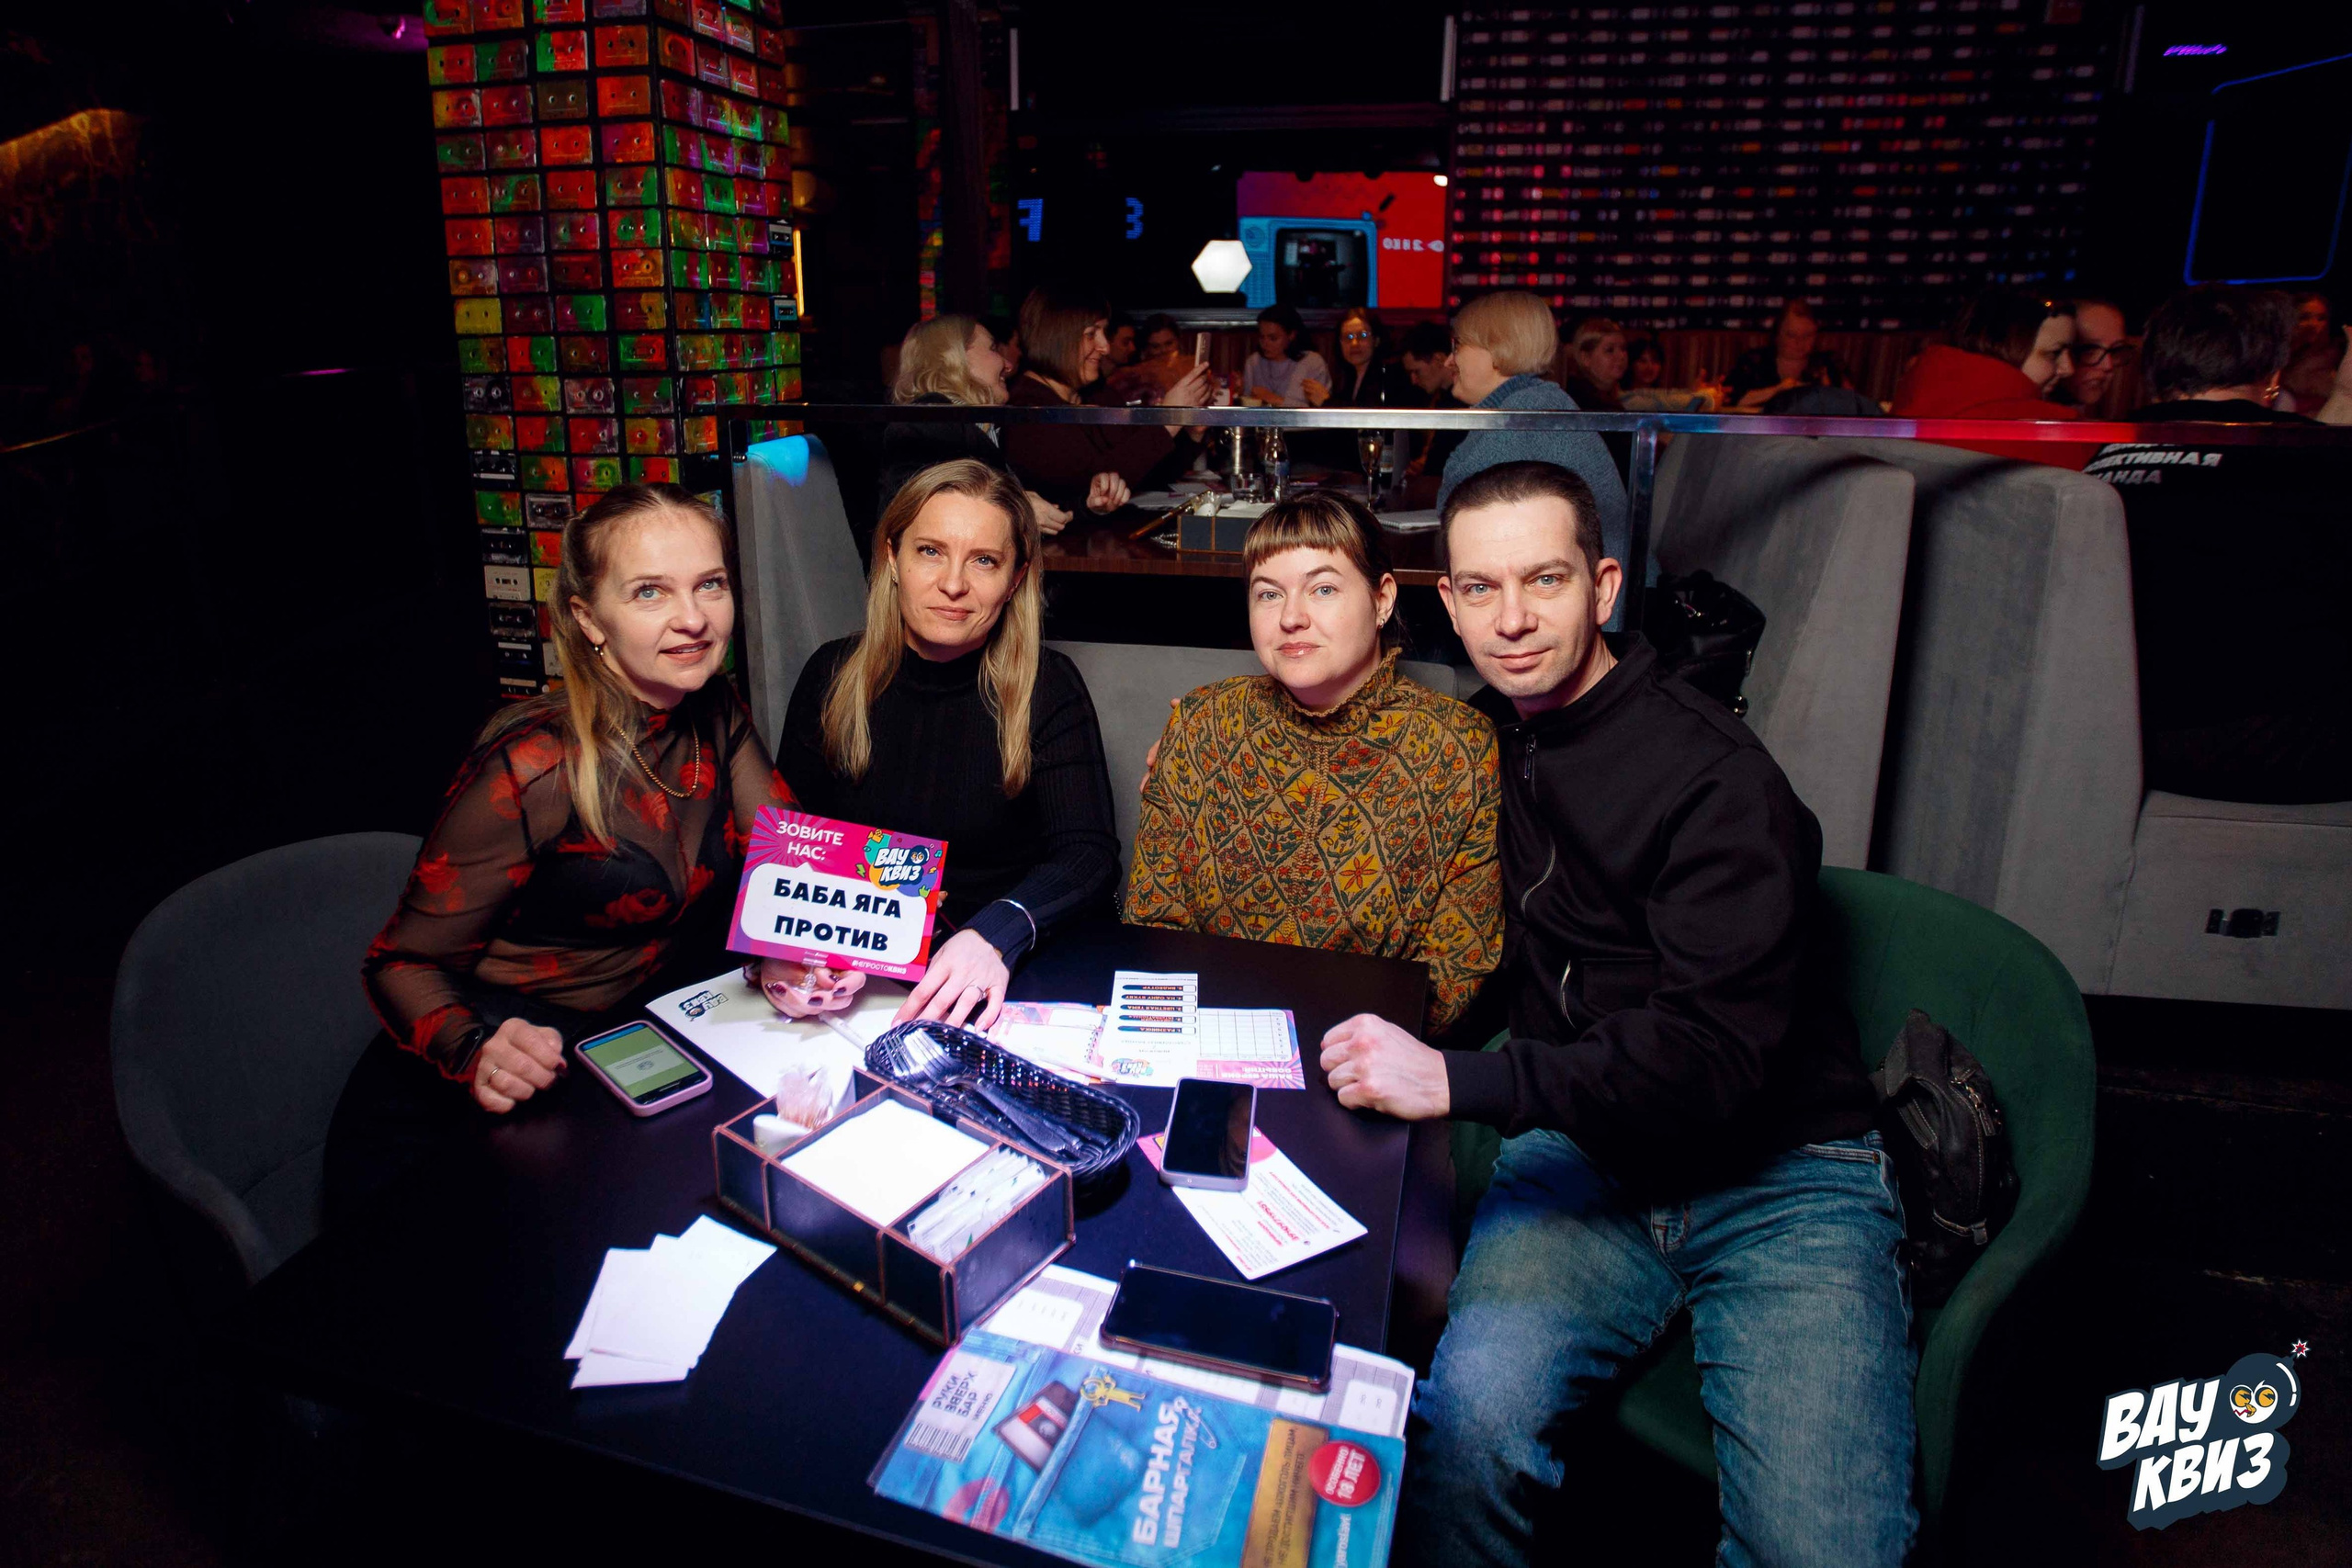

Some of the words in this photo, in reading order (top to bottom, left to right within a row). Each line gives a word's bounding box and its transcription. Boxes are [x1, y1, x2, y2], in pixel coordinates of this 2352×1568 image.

[776, 820, 844, 846] ЗОВИТЕ
[786, 842, 827, 861] НАС:
[874, 847, 910, 869] ВАУ
[880, 863, 922, 882] КВИЗ
[774, 877, 846, 908] БАБА
[852, 894, 901, 919] ЯГА
[774, 915, 888, 952] ПРОТИВ
[931, 1373, 960, 1411] РУКИ
[956, 1389, 979, 1417] БАР
[972, 1392, 993, 1422] МЕНЮ
[1131, 1401, 1182, 1547] БАРНАЯ
[1162, 1407, 1203, 1549] ШПАРГАЛКА
[1324, 1446, 1350, 1495] ОСОБЕННО
[1343, 1450, 1366, 1483] ЛЕТ
[1337, 1477, 1355, 1500] 18
